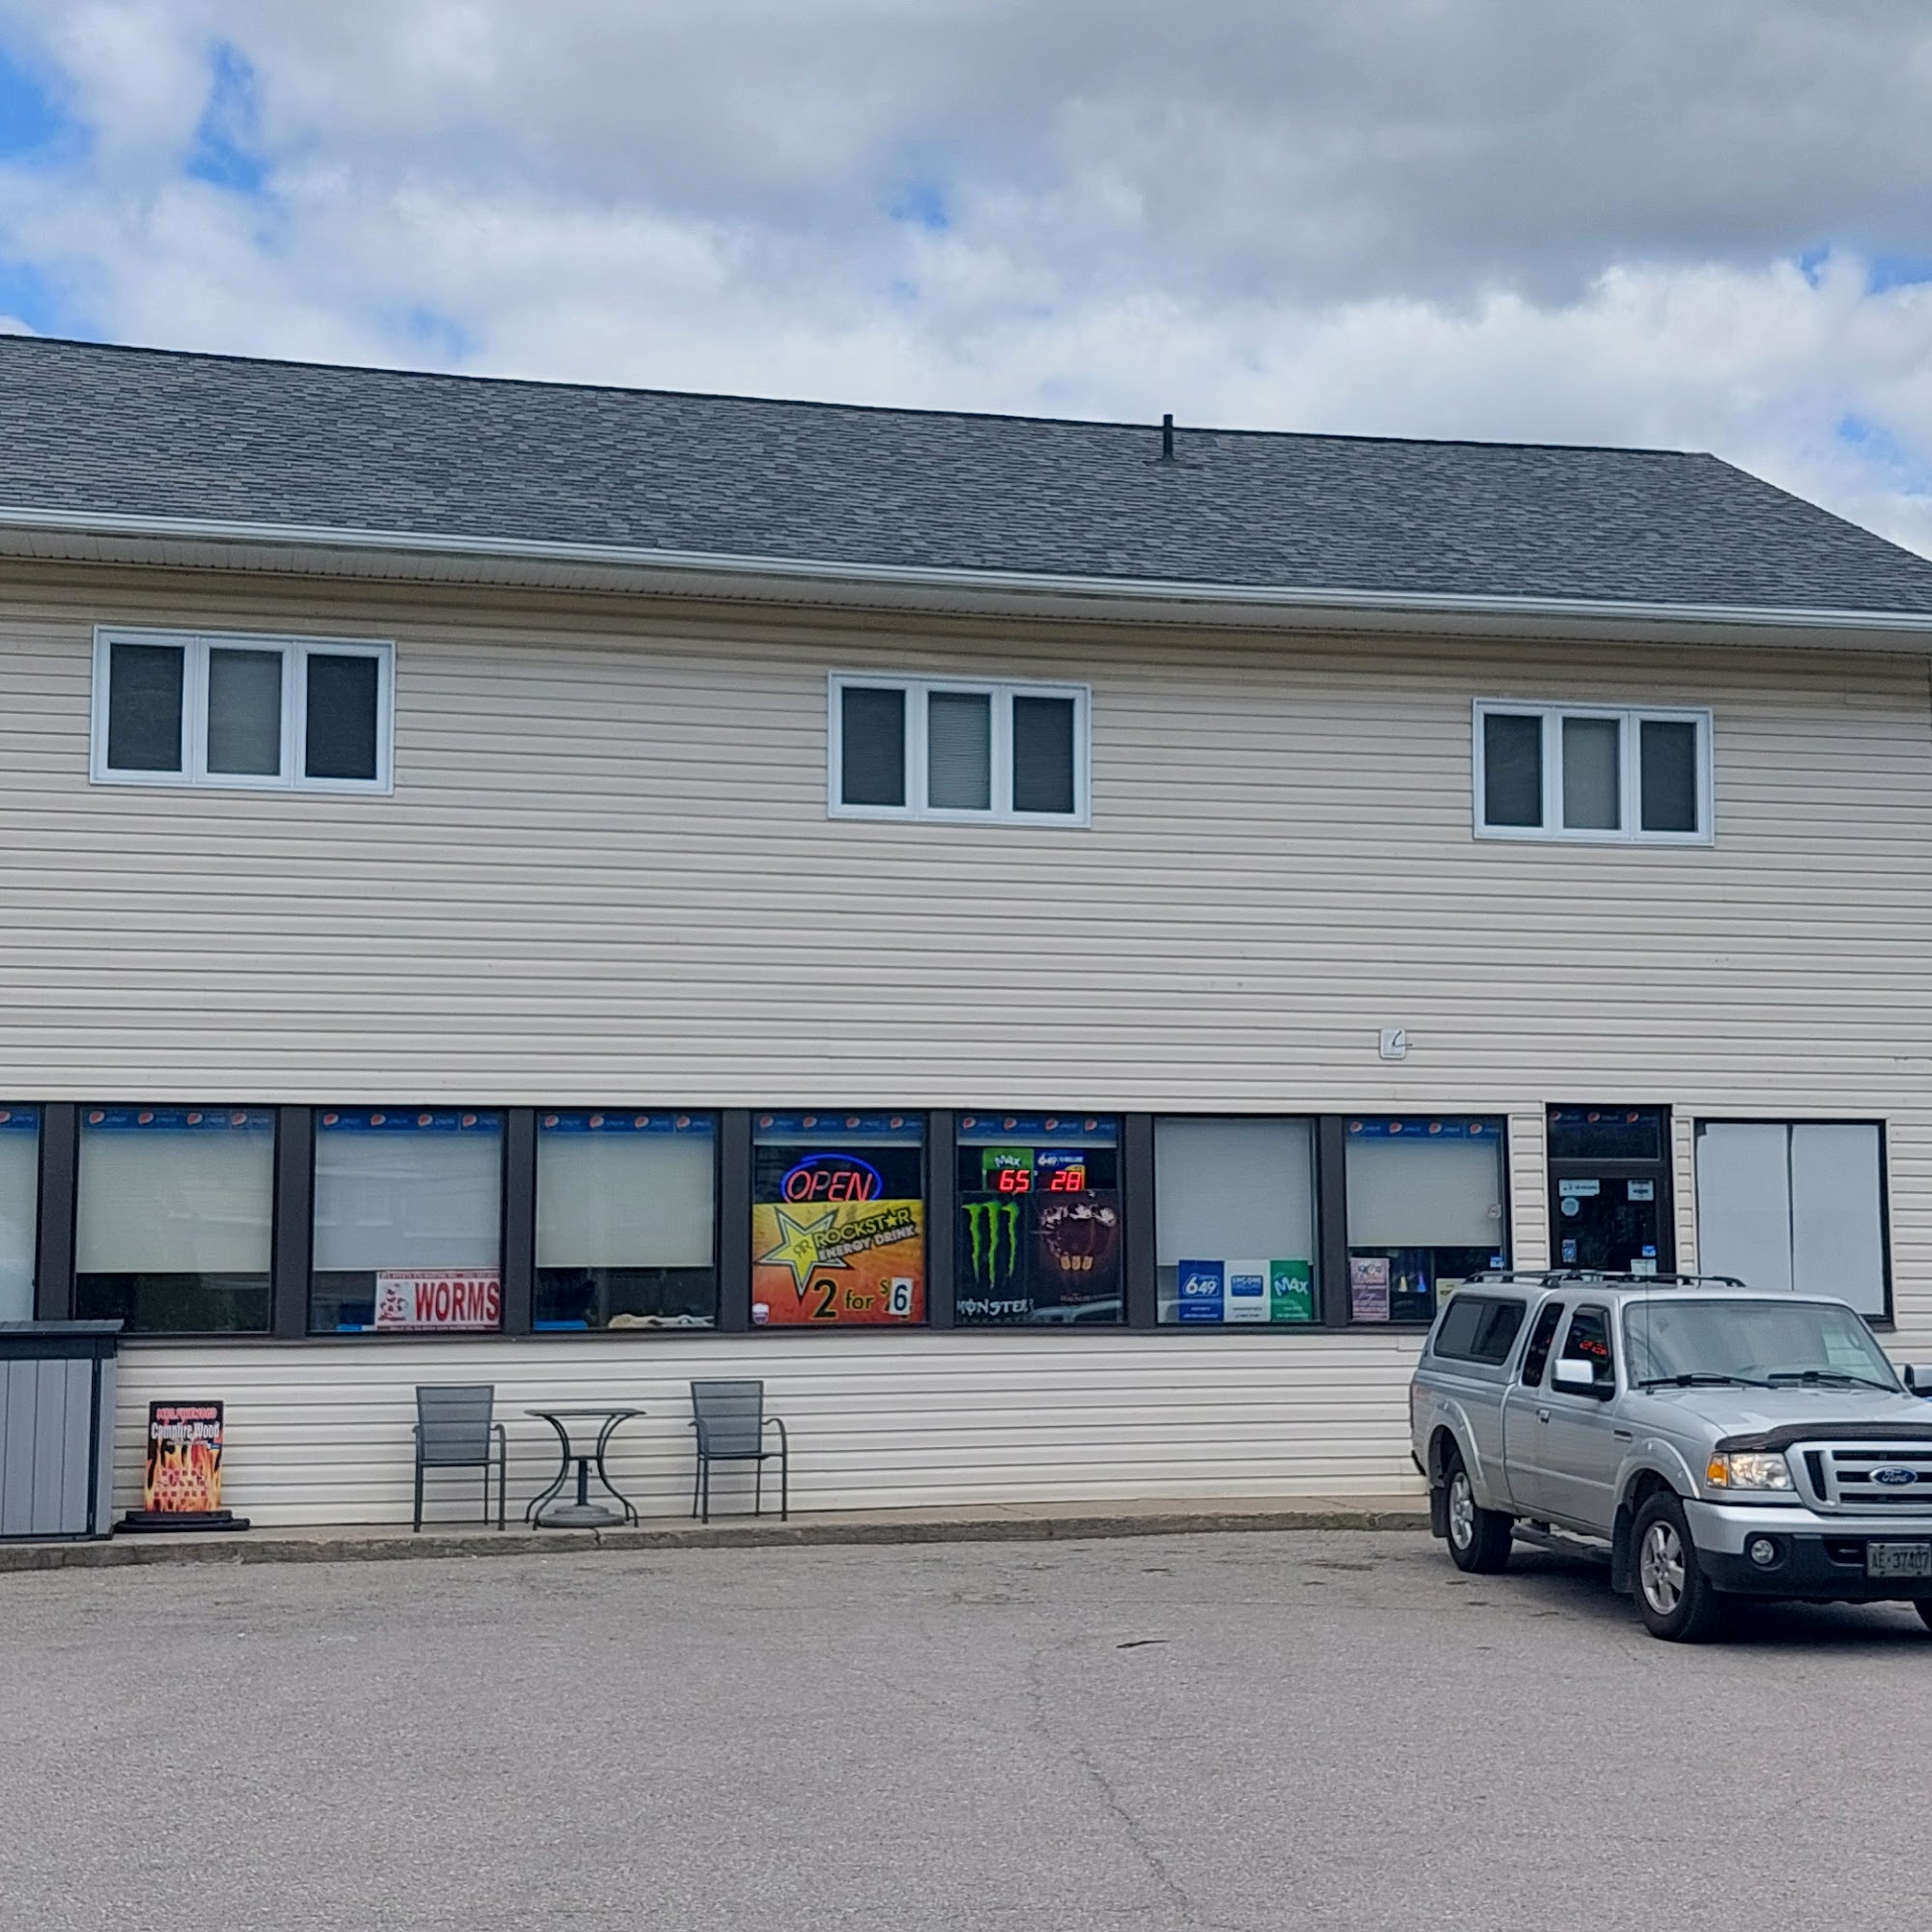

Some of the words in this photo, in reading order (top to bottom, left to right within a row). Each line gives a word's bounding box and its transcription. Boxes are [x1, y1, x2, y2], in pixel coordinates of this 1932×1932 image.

[786, 1170, 873, 1202] OPEN
[999, 1170, 1031, 1192] 65
[1051, 1171, 1083, 1191] 28
[818, 1237, 870, 1262] ENERGY
[873, 1224, 916, 1246] DRINK
[414, 1281, 500, 1322] WORMS
[812, 1278, 838, 1319] 2
[845, 1289, 874, 1310] for
[151, 1422, 193, 1443] Campfire
[193, 1421, 221, 1439] Wood
[1881, 1468, 1909, 1483] Ford
